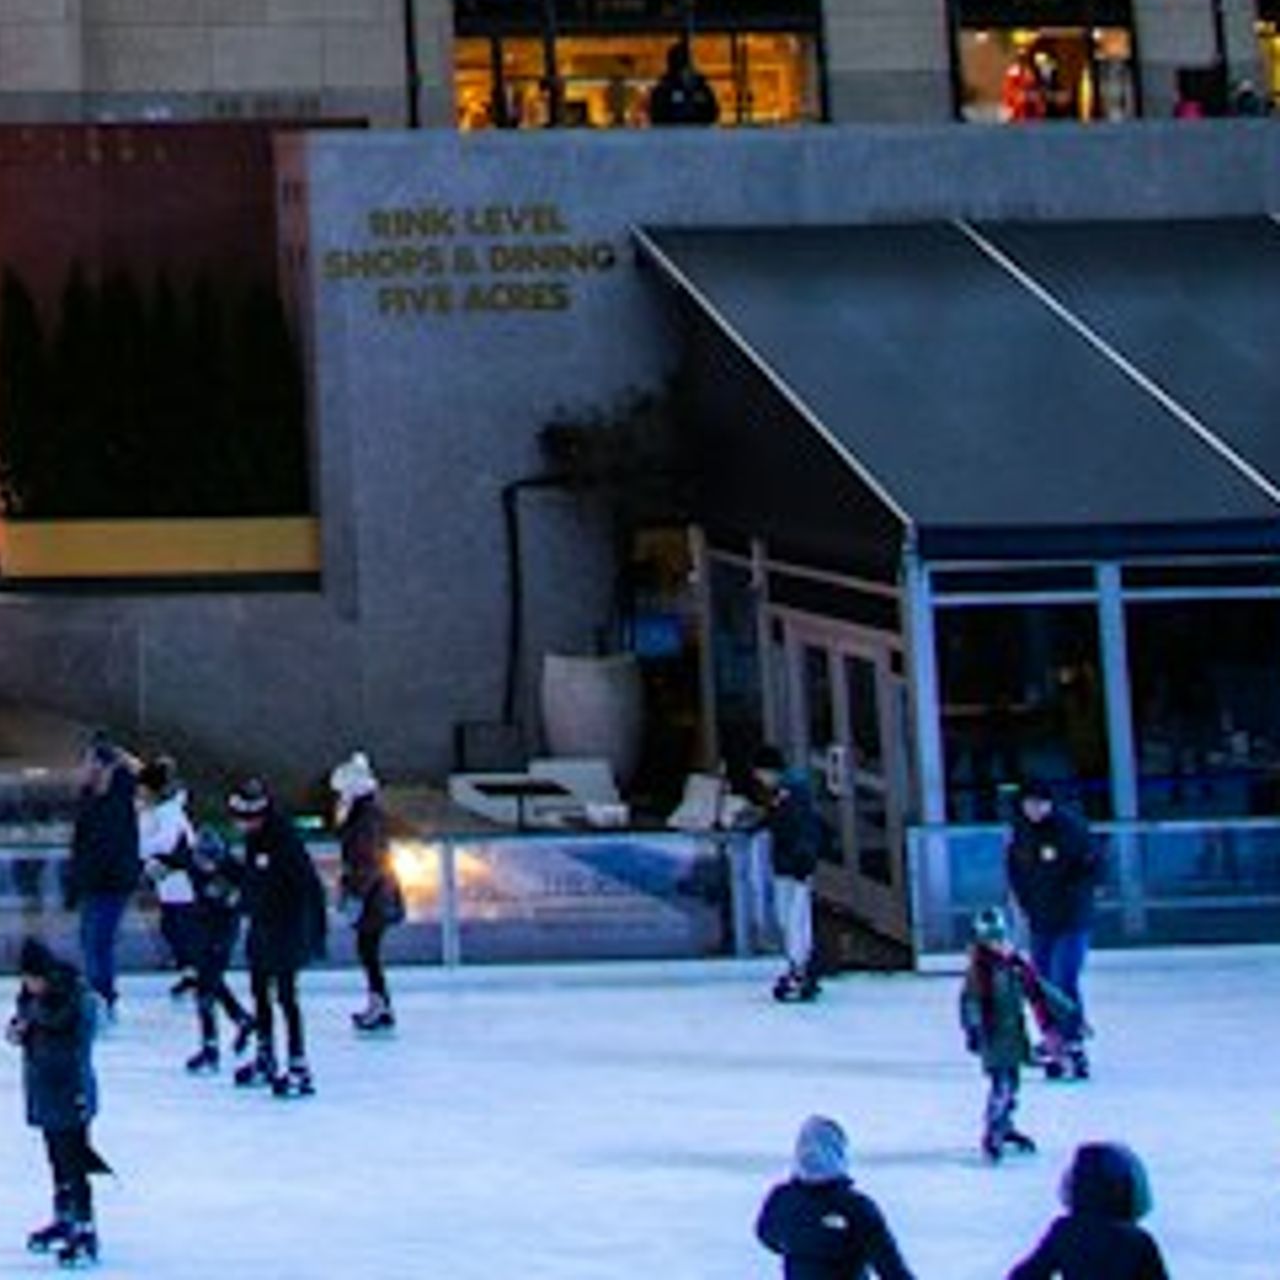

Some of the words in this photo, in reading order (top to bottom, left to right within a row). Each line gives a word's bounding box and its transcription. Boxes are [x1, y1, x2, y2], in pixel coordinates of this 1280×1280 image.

[368, 207, 454, 236] RINK
[465, 204, 568, 234] LEVEL
[323, 246, 445, 278] SHOPS
[490, 242, 617, 272] DINING
[378, 285, 452, 315] FIVE
[463, 282, 570, 311] ACRES
